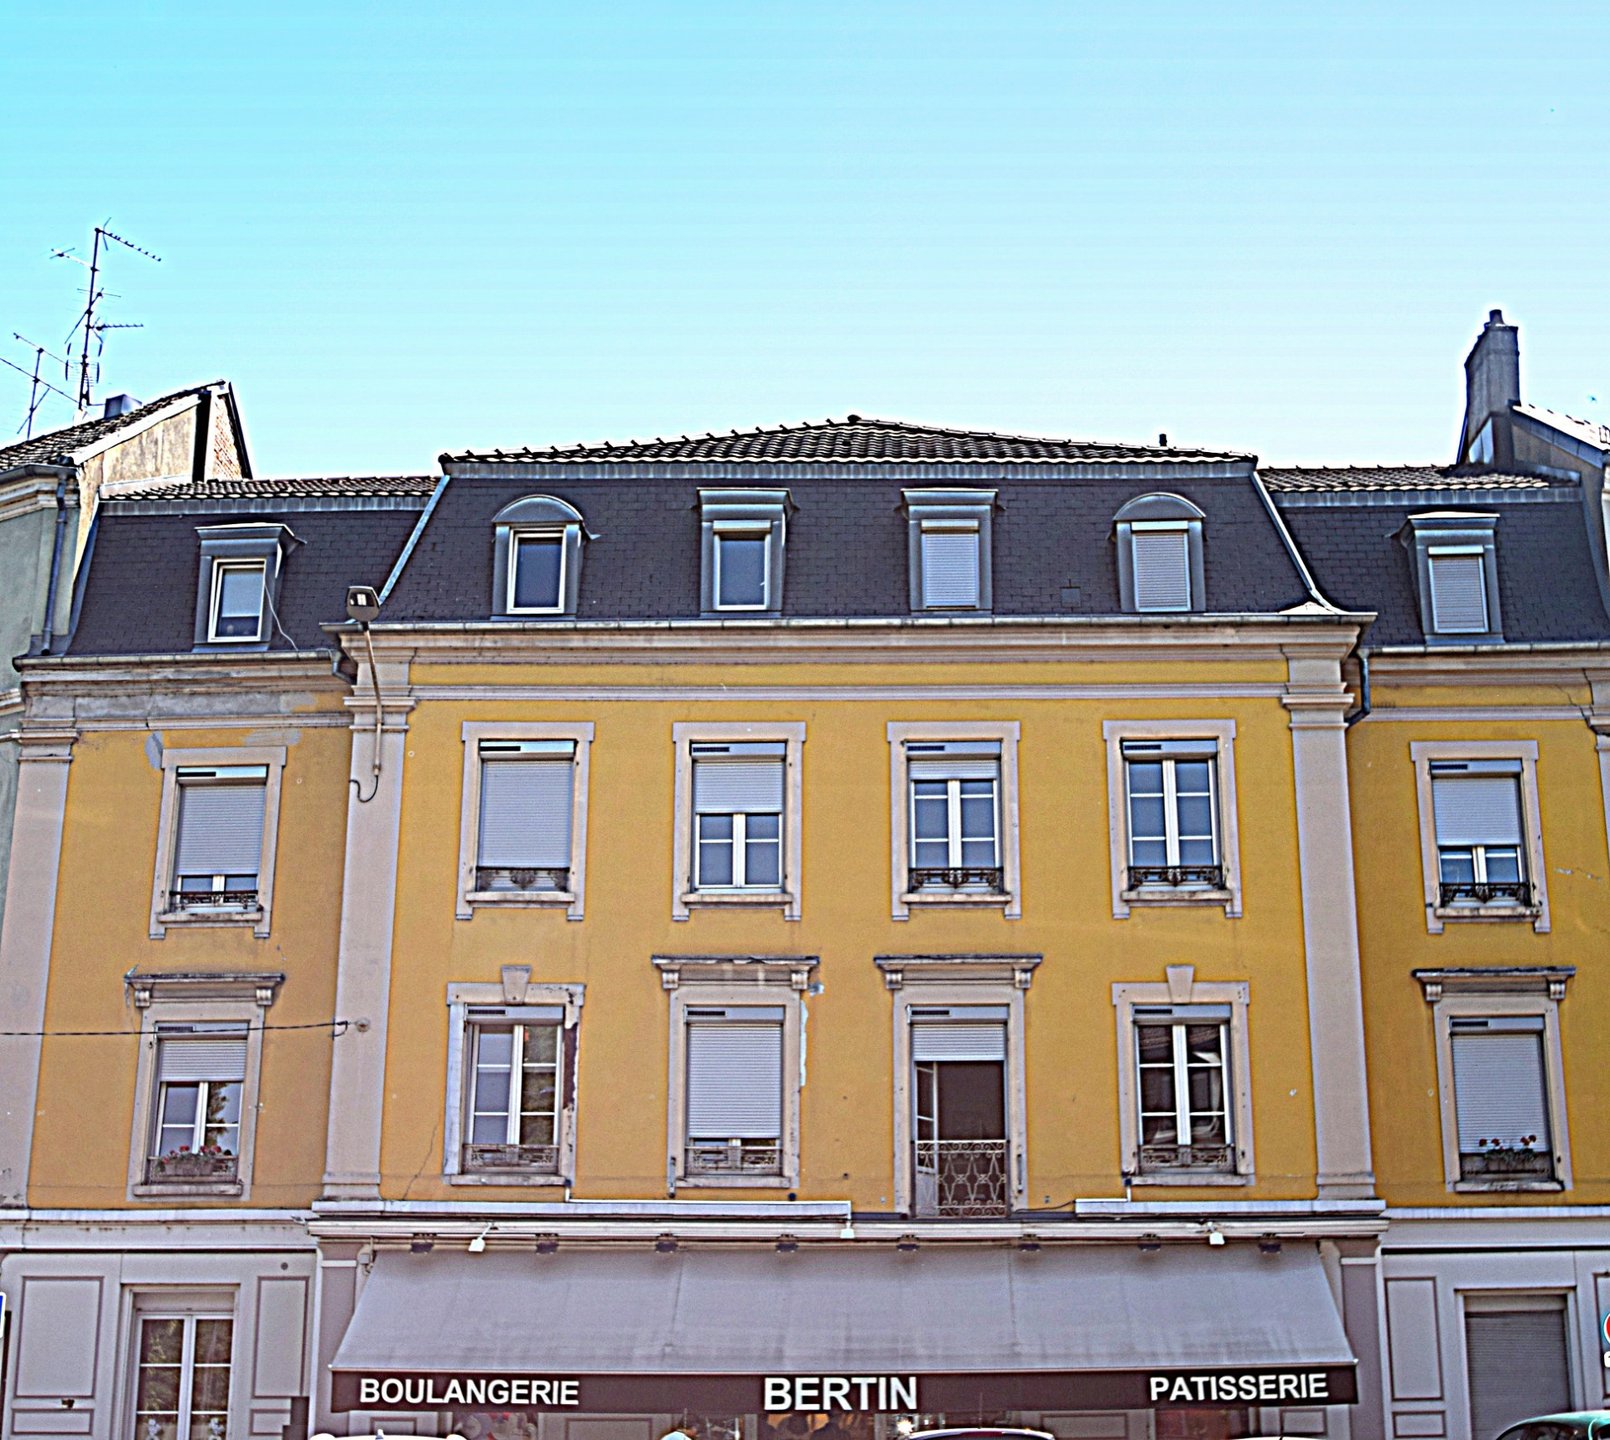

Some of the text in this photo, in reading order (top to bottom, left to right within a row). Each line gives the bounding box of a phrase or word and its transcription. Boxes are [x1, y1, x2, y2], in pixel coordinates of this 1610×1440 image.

[359, 1373, 1329, 1411] BOULANGERIE BERTIN PATISSERIE
